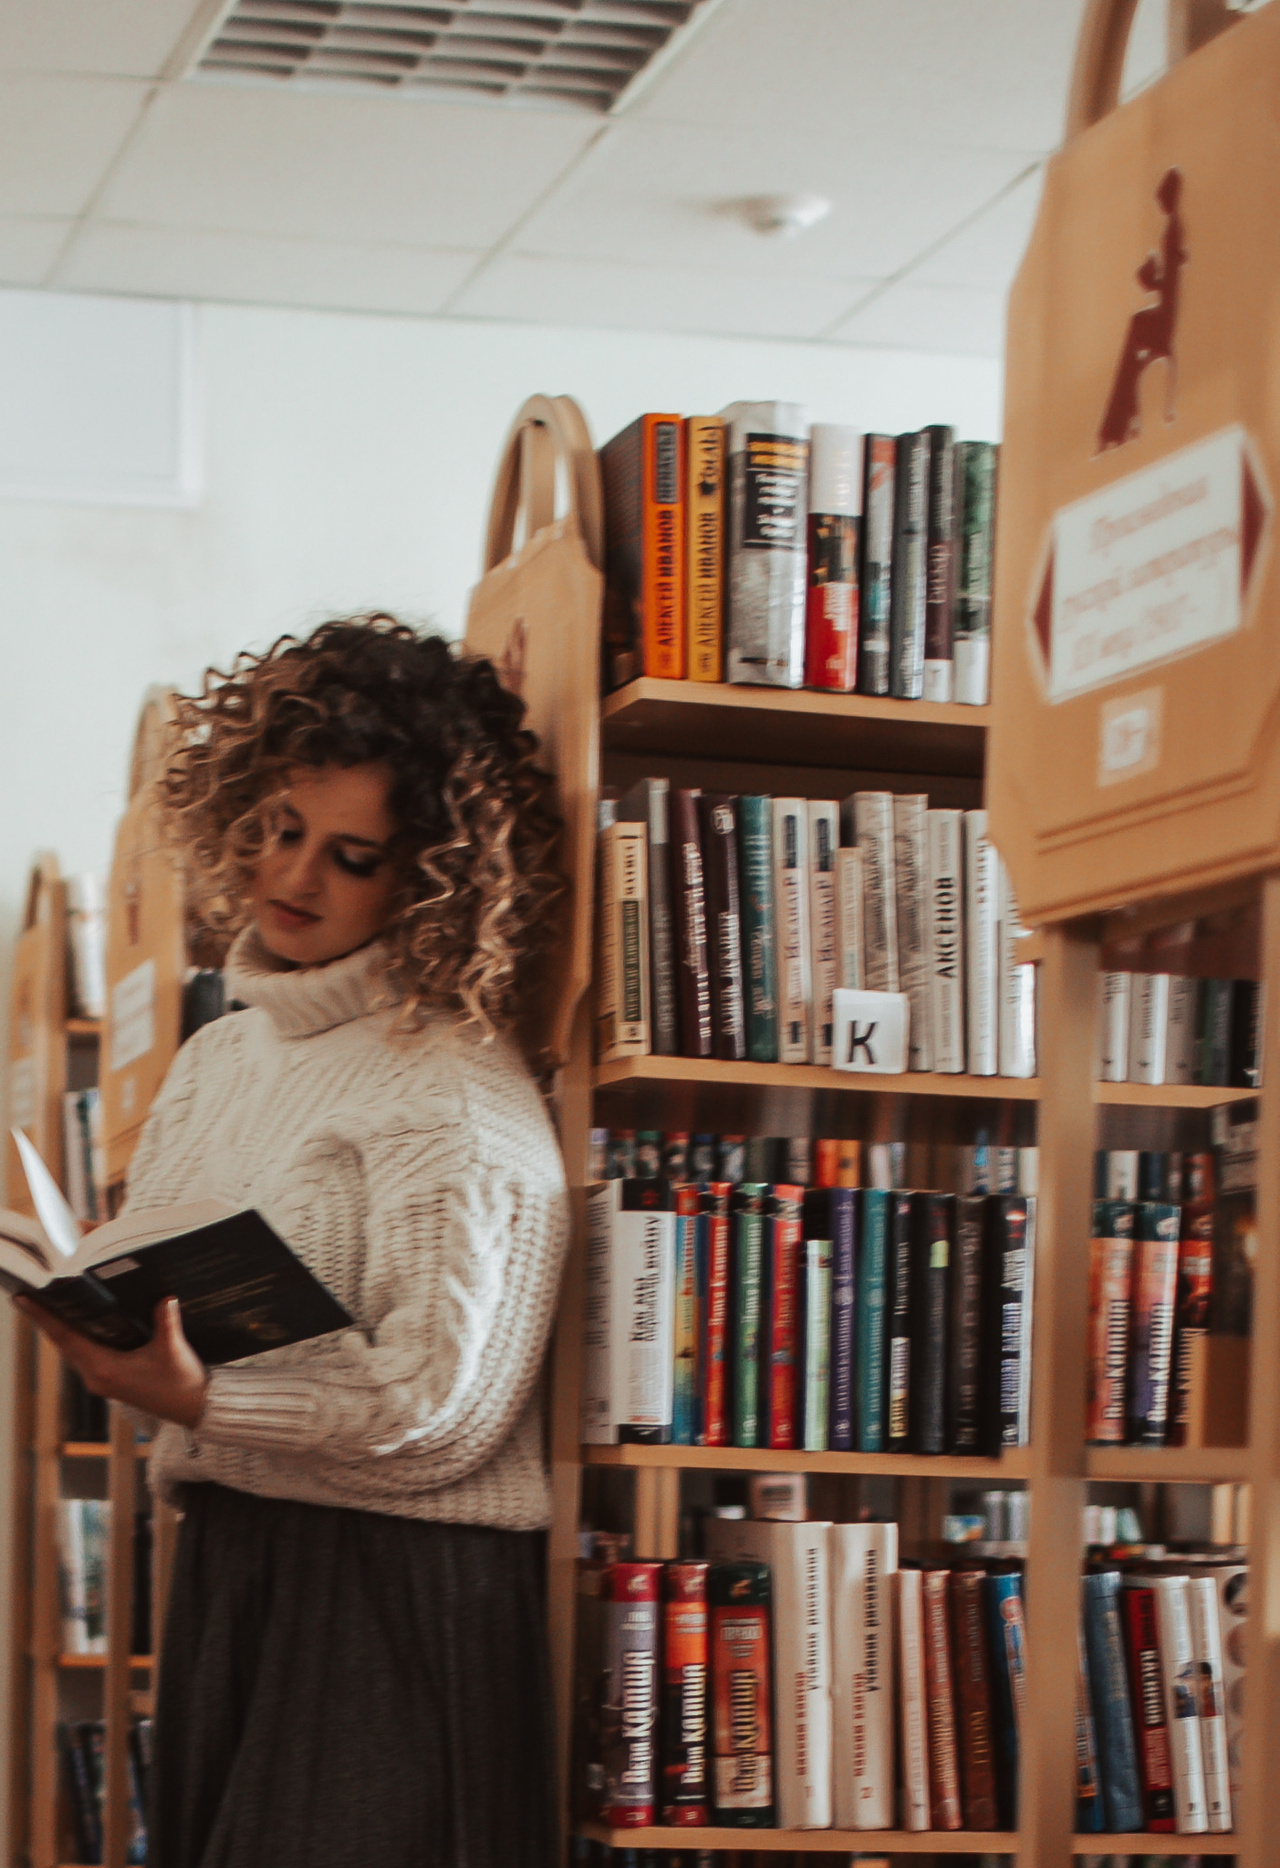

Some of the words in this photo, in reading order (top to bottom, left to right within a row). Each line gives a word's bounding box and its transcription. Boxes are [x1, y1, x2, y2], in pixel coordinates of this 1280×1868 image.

[656, 510, 675, 578] ИВАНОВ
[699, 512, 717, 579] ИВАНОВ
[656, 582, 676, 647] АЛЕКСЕЙ
[698, 585, 718, 647] АЛЕКСЕЙ
[640, 1217, 660, 1270] войну
[864, 1549, 881, 1628] рисования
[622, 1649, 656, 1738] КАМША
[681, 1663, 707, 1742] КАМША
[730, 1670, 760, 1750] КАМША
